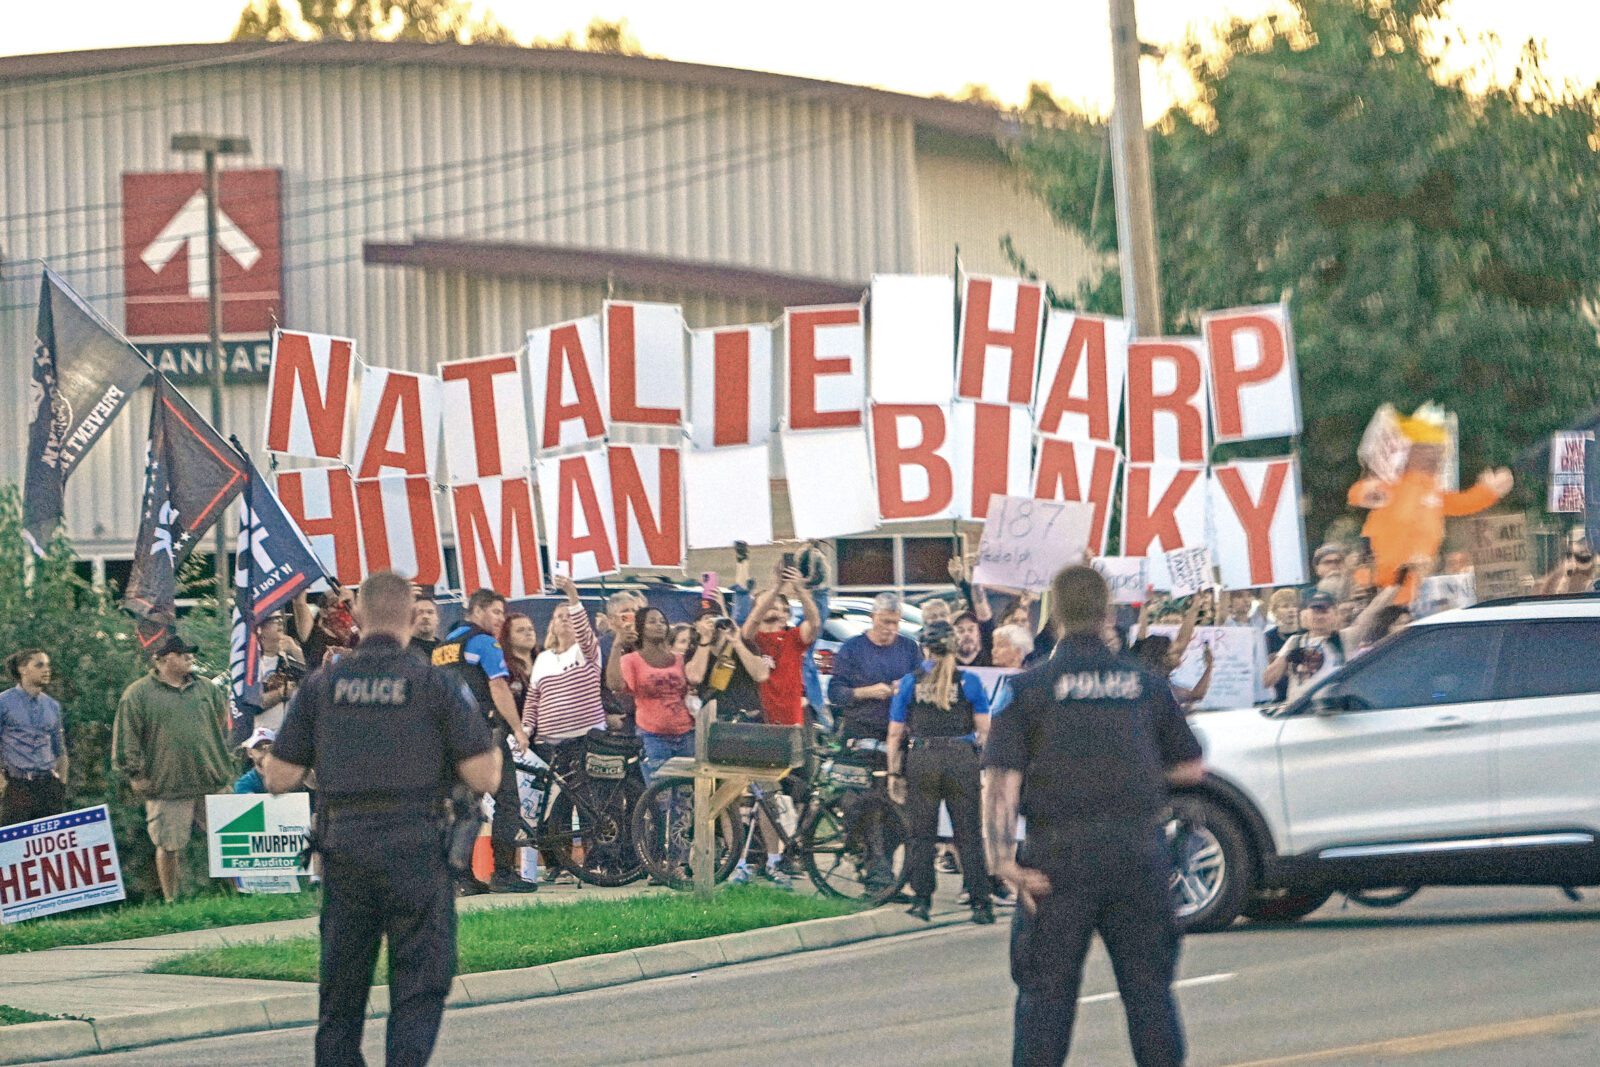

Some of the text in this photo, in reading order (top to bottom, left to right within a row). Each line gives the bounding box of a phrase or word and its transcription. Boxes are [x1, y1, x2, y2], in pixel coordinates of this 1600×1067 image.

[268, 279, 1286, 478] NATALIE HARP
[278, 446, 680, 598] HUMAN
[872, 403, 1289, 585] BINKY
[334, 678, 407, 704] POLICE
[32, 820, 61, 834] KEEP
[23, 831, 78, 858] JUDGE
[251, 834, 306, 853] MURPHY
[0, 843, 117, 904] HENNE
[231, 858, 295, 868] For Auditor
